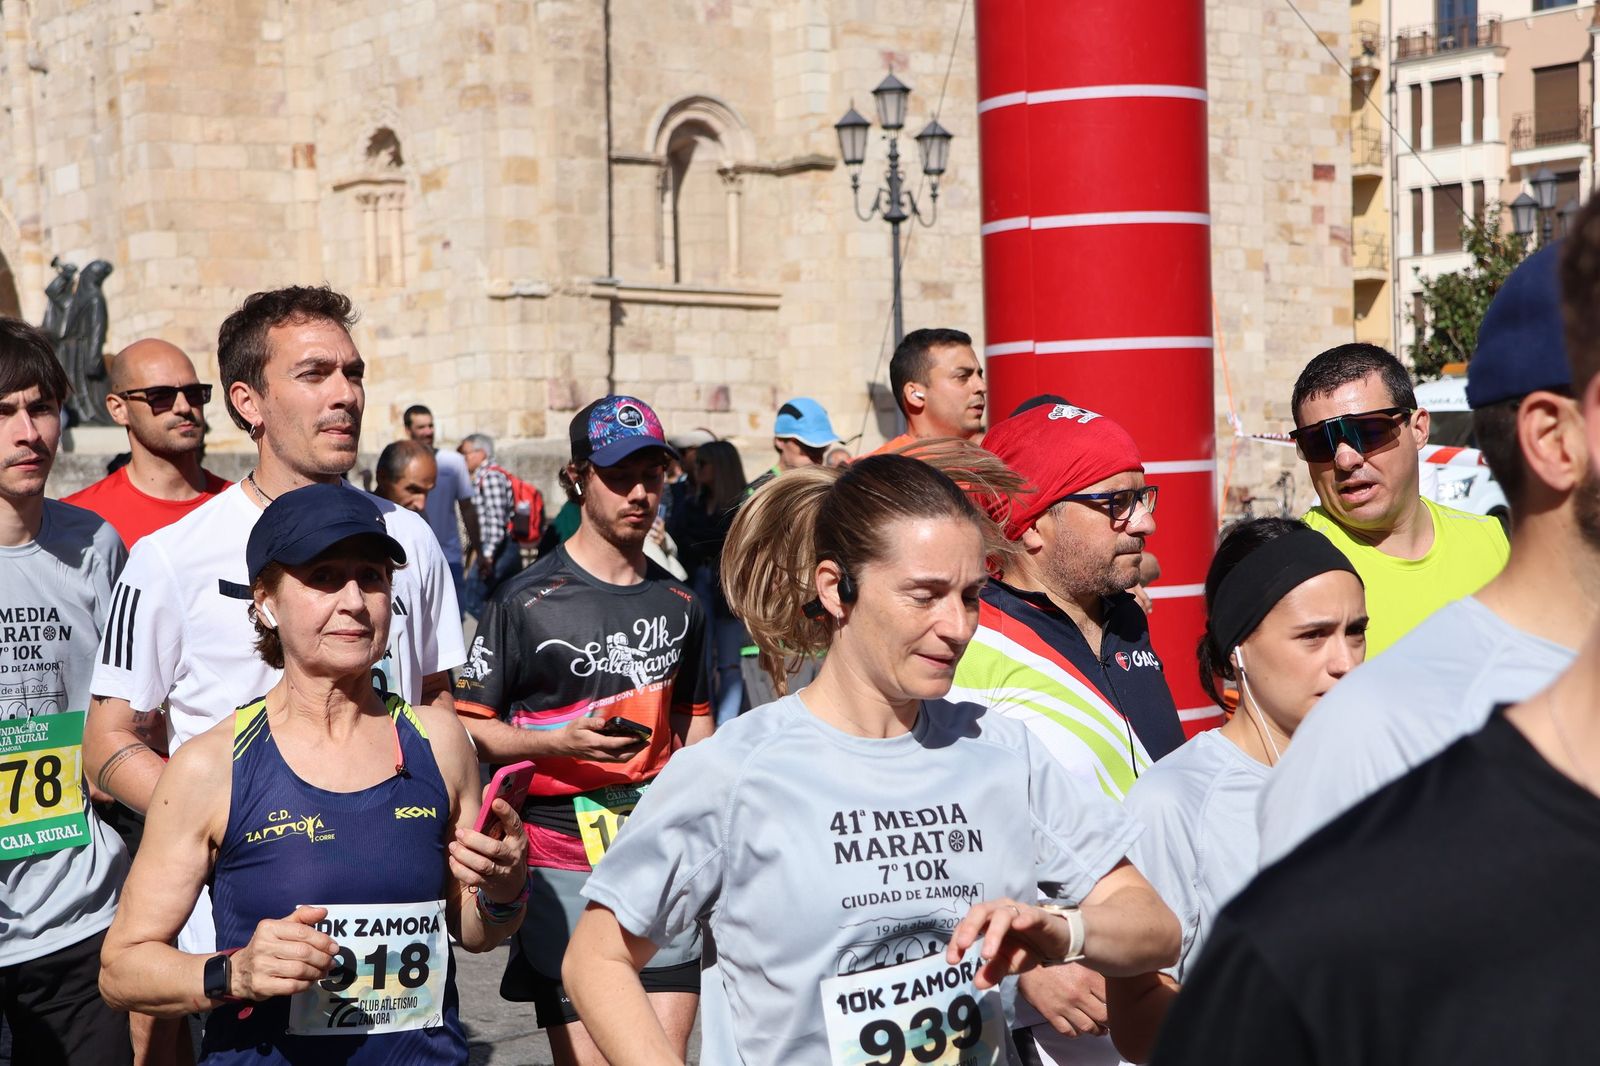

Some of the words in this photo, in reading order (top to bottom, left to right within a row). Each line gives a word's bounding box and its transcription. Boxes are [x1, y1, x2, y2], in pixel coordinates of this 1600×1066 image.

[0, 608, 60, 623] MEDIA
[13, 645, 43, 660] 10K
[15, 732, 48, 744] RURAL
[268, 810, 291, 821] C.D.
[872, 803, 968, 831] MEDIA
[1, 833, 35, 849] CAJA
[36, 824, 83, 843] RURAL
[315, 834, 335, 842] CORRE
[903, 859, 950, 882] 10K
[842, 890, 902, 909] CIUDAD
[906, 890, 922, 901] DE
[926, 885, 979, 898] ZAMORA
[354, 915, 440, 937] ZAMORA
[876, 925, 890, 936] 19
[893, 922, 908, 933] de
[939, 917, 965, 930] 202
[320, 942, 430, 992] 918
[360, 999, 379, 1012] CLUB
[380, 997, 418, 1010] ATLETISMO
[836, 987, 886, 1015] 10K
[358, 1012, 390, 1025] ZAMORA
[859, 994, 982, 1066] 939
